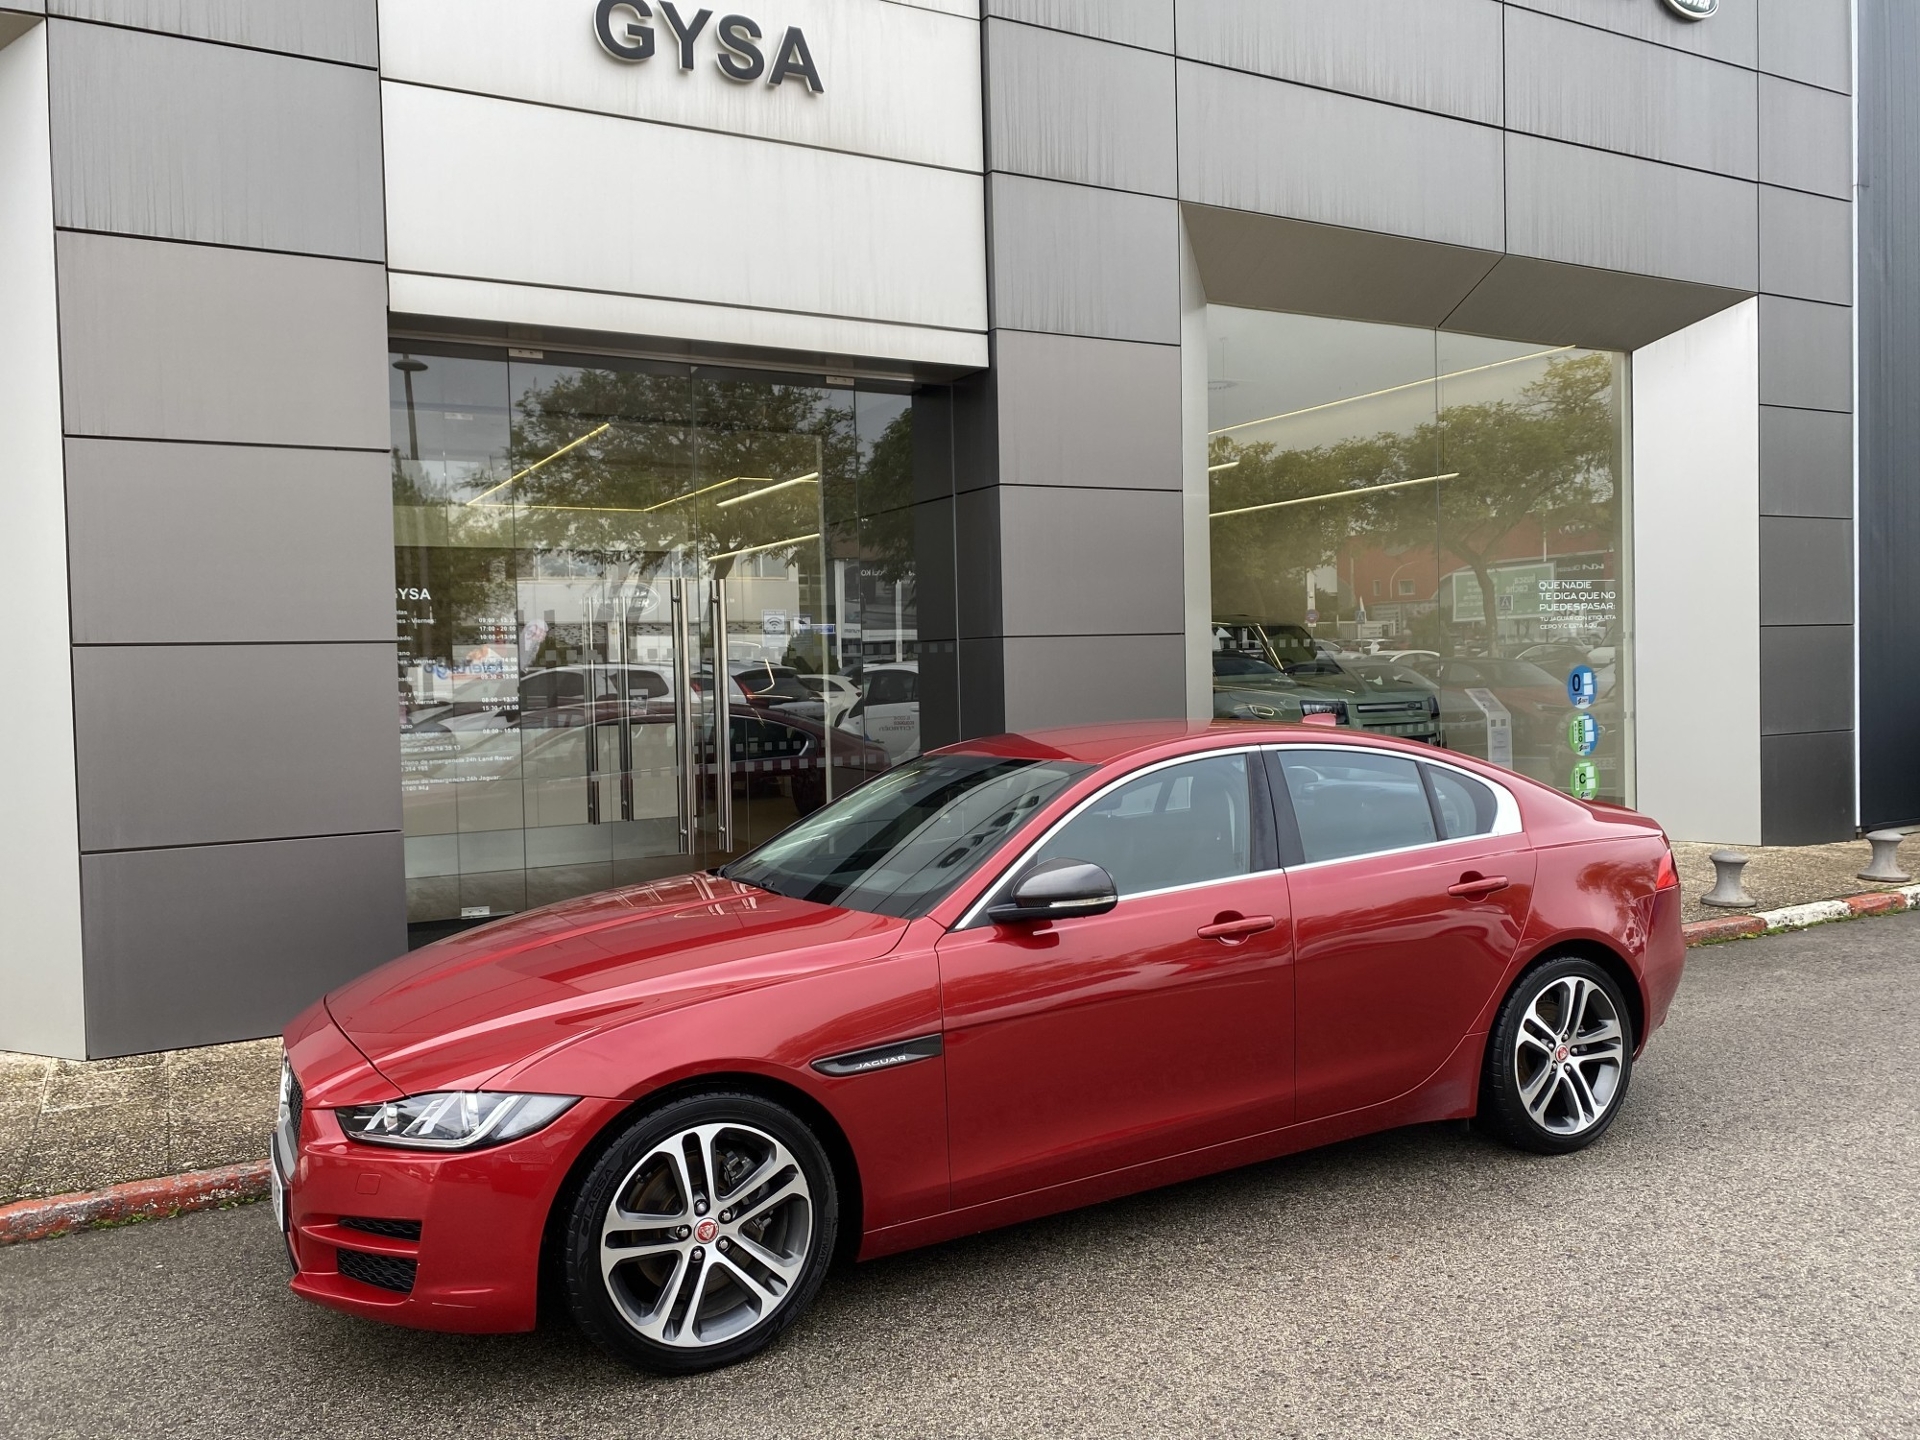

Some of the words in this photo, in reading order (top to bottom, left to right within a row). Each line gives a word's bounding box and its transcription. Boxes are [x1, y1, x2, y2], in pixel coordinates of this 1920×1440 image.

[593, 0, 824, 95] GYSA
[1538, 581, 1560, 591] QUE
[1562, 581, 1592, 589] NADIE
[395, 588, 431, 600] YSA
[1539, 592, 1552, 600] TE
[1553, 592, 1577, 600] DIGA
[1578, 591, 1600, 601] QUE
[1600, 591, 1616, 599] NO
[1539, 603, 1580, 611] PUEDES
[1572, 673, 1581, 692] 0
[430, 777, 466, 785] emergencia
[1579, 772, 1586, 784] C
[855, 1055, 906, 1070] JAGUAR
